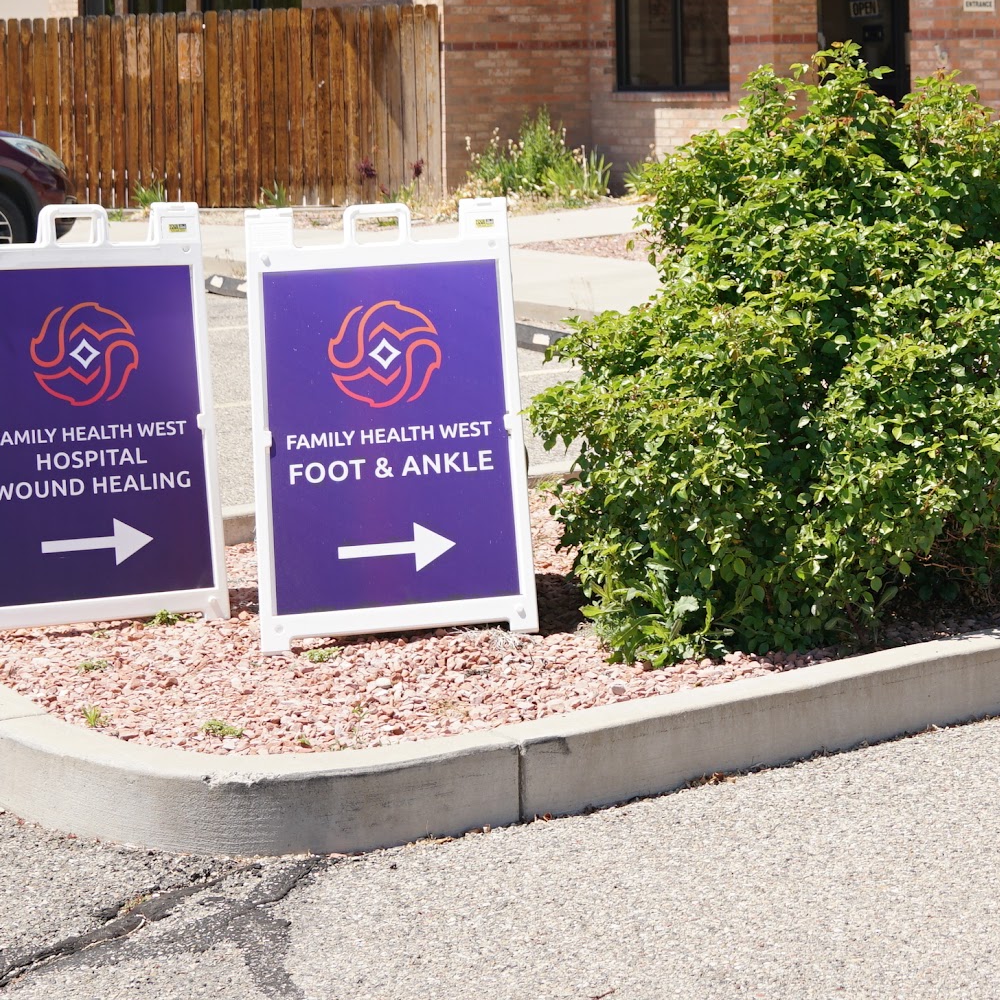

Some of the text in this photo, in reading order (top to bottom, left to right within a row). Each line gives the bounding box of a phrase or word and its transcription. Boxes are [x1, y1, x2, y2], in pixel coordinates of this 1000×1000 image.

[852, 1, 877, 16] OPEN
[965, 0, 992, 8] ENTRANCE
[0, 420, 187, 446] AMILY HEALTH WEST
[286, 421, 493, 450] FAMILY HEALTH WEST
[36, 447, 148, 471] HOSPITAL
[289, 450, 494, 485] FOOT & ANKLE
[92, 470, 191, 495] HEALING
